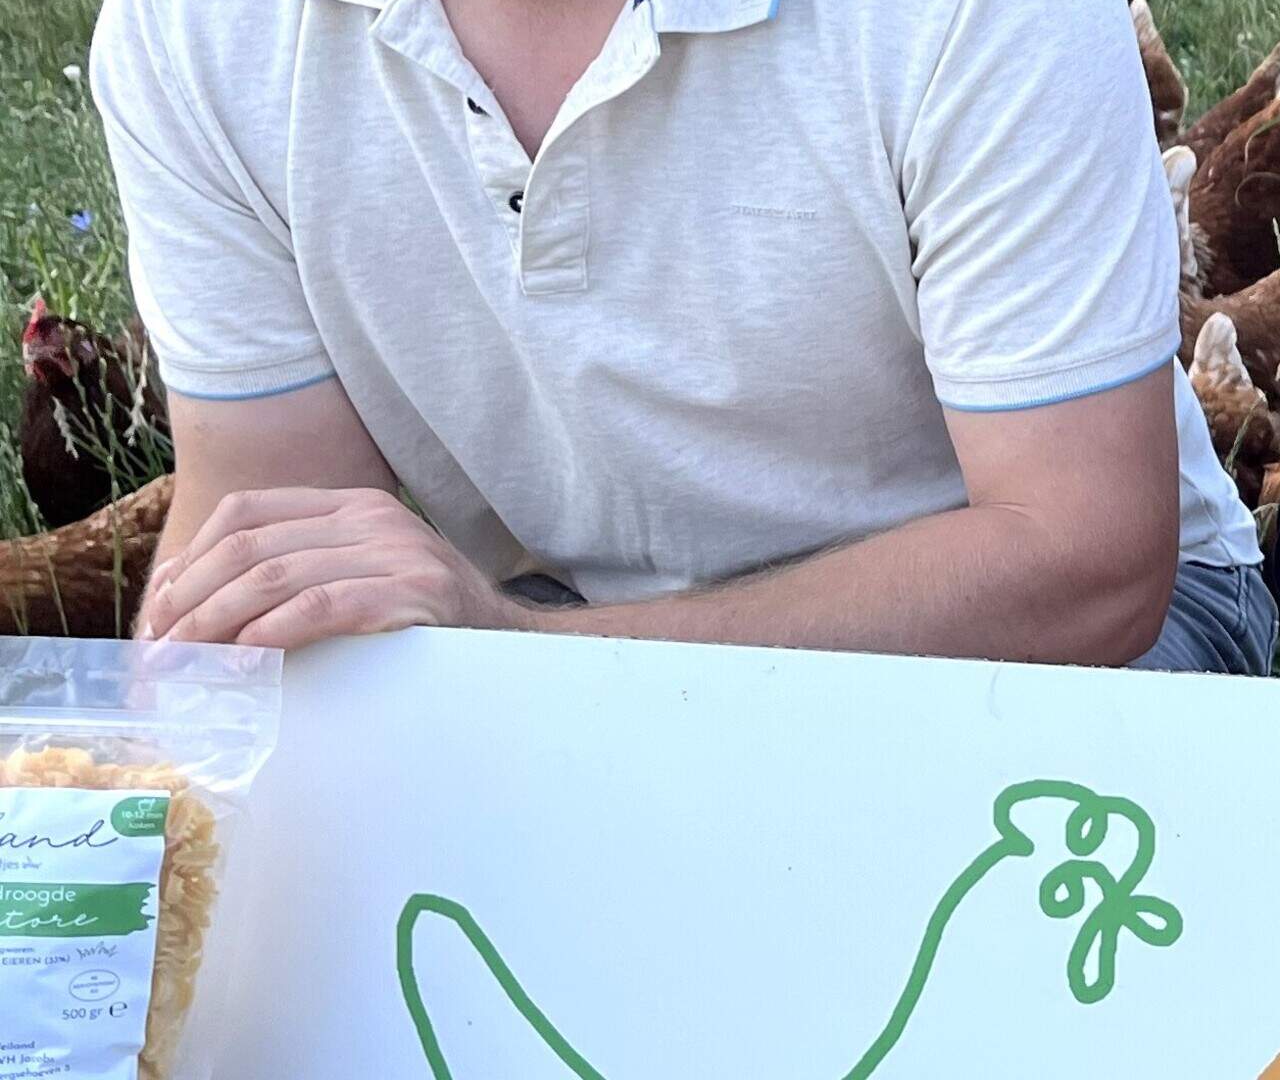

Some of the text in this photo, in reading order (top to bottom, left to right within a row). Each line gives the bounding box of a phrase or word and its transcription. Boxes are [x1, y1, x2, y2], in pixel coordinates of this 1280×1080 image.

[0, 885, 76, 908] roogde
[62, 1007, 87, 1021] 500
[89, 1007, 103, 1021] gr
[0, 1040, 35, 1051] eiland
